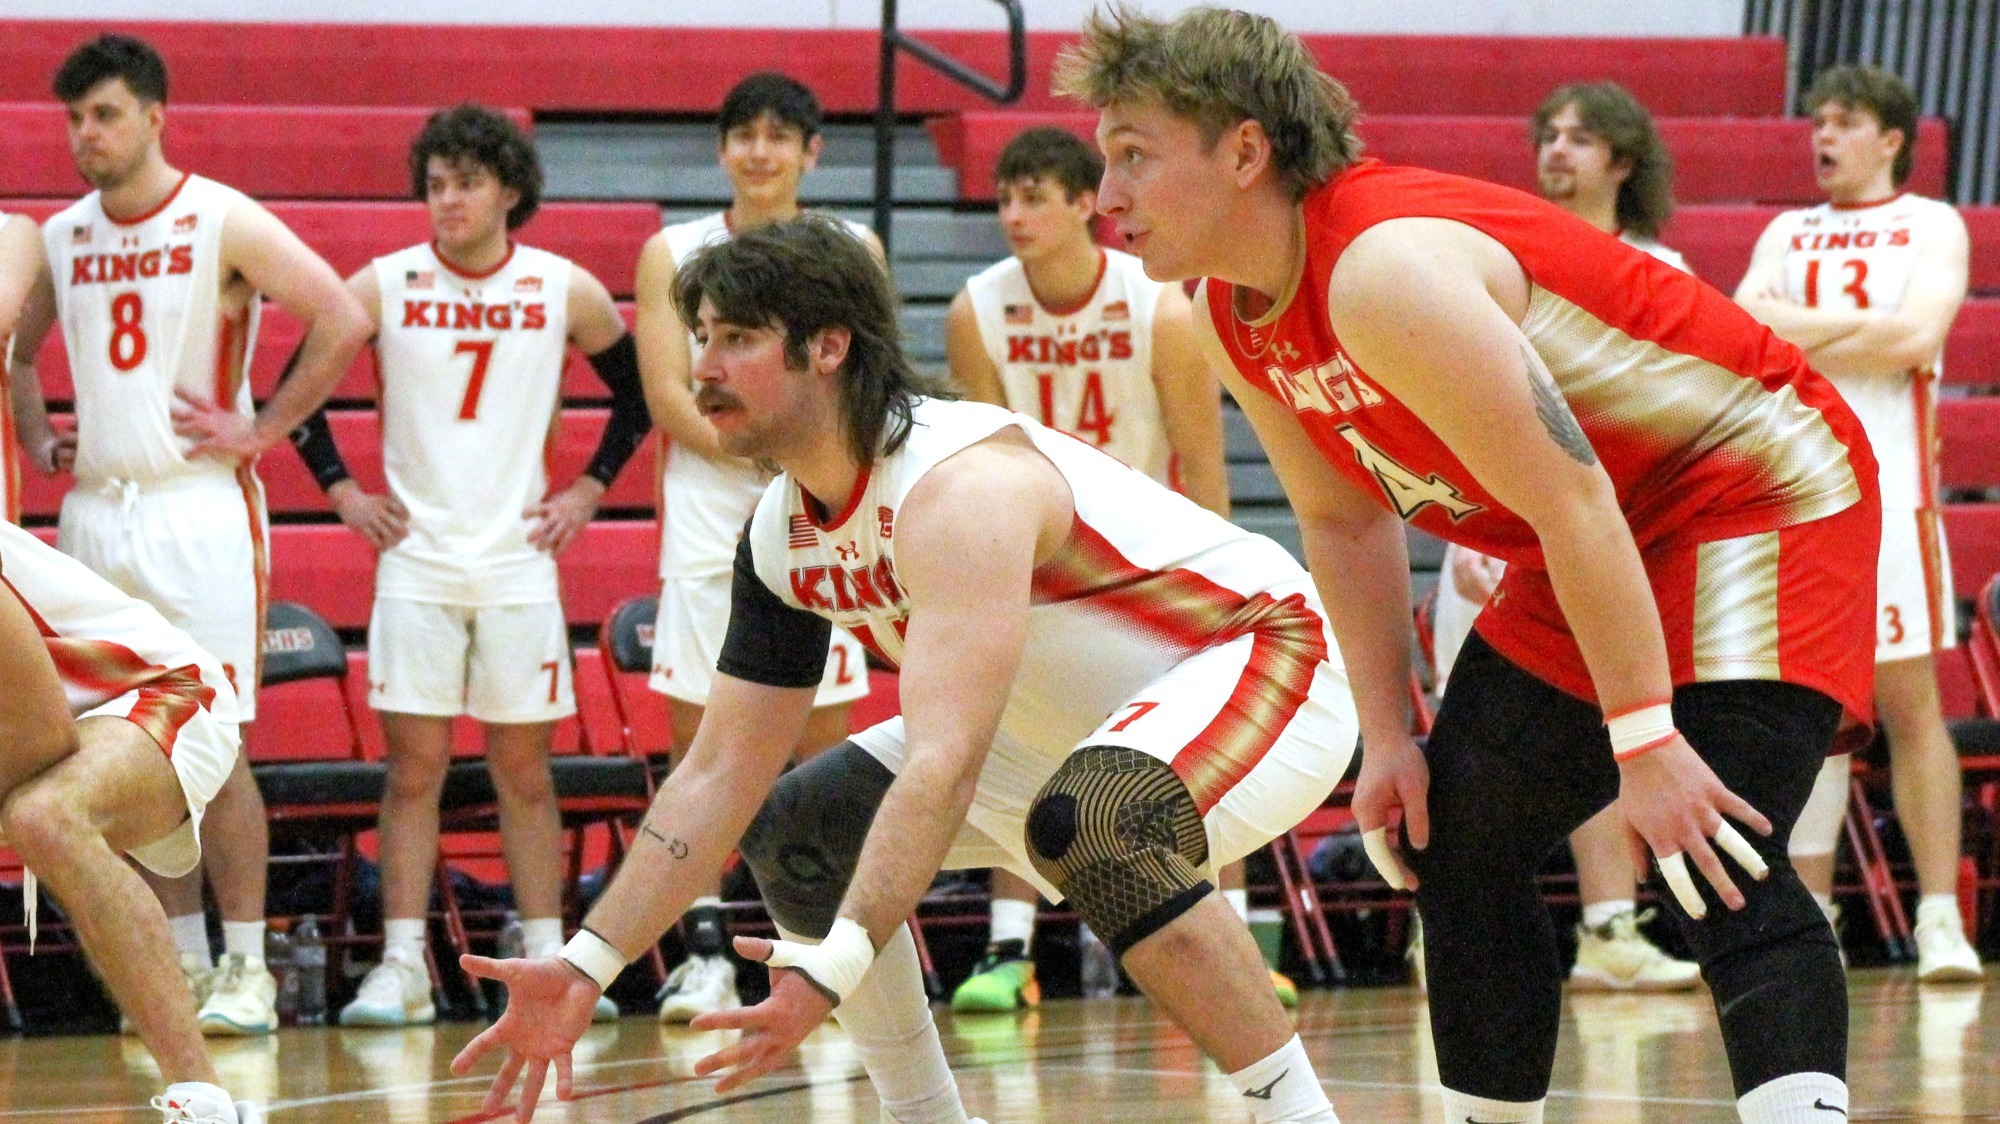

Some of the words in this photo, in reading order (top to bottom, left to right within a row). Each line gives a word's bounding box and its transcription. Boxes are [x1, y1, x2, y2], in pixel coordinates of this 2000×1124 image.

[71, 245, 193, 285] KING'S
[109, 292, 147, 371] 8
[402, 300, 546, 330] KING'S
[1008, 330, 1133, 366] KING'S
[454, 340, 495, 420] 7
[1038, 371, 1116, 445] 14
[1335, 422, 1487, 525] 4
[1883, 604, 1905, 644] 3
[541, 661, 560, 703] 7
[831, 644, 853, 685] 2
